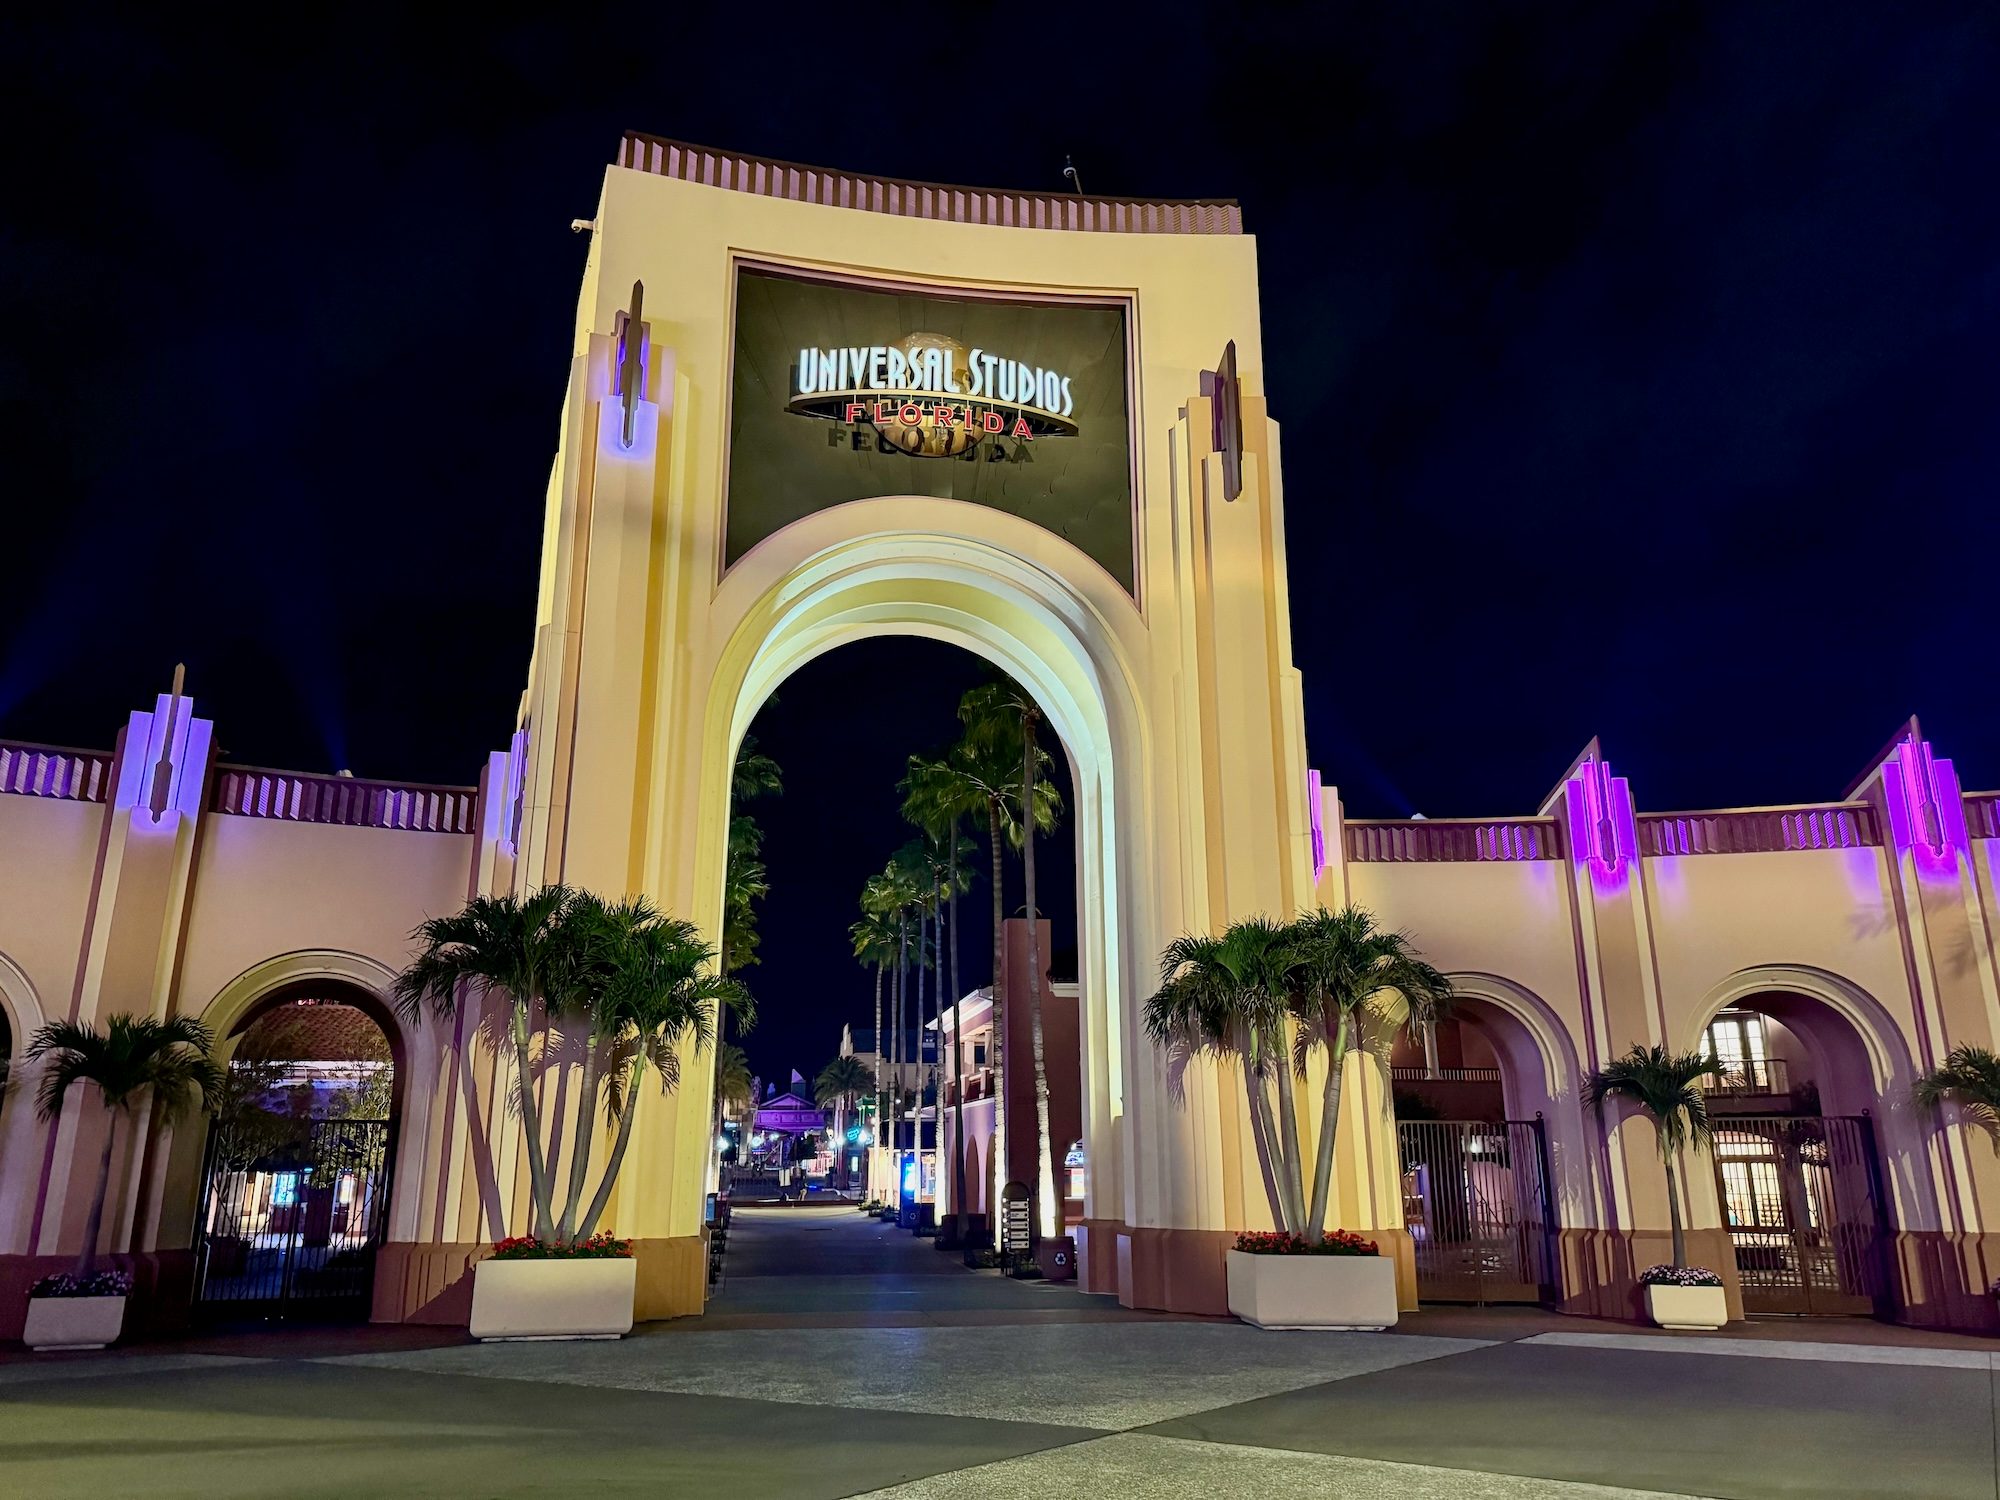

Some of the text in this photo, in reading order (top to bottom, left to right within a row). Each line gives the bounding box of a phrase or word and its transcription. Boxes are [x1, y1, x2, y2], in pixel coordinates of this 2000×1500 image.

[799, 346, 1073, 417] UNIVERSAL STUDIOS
[845, 403, 1034, 441] FLORIDA
